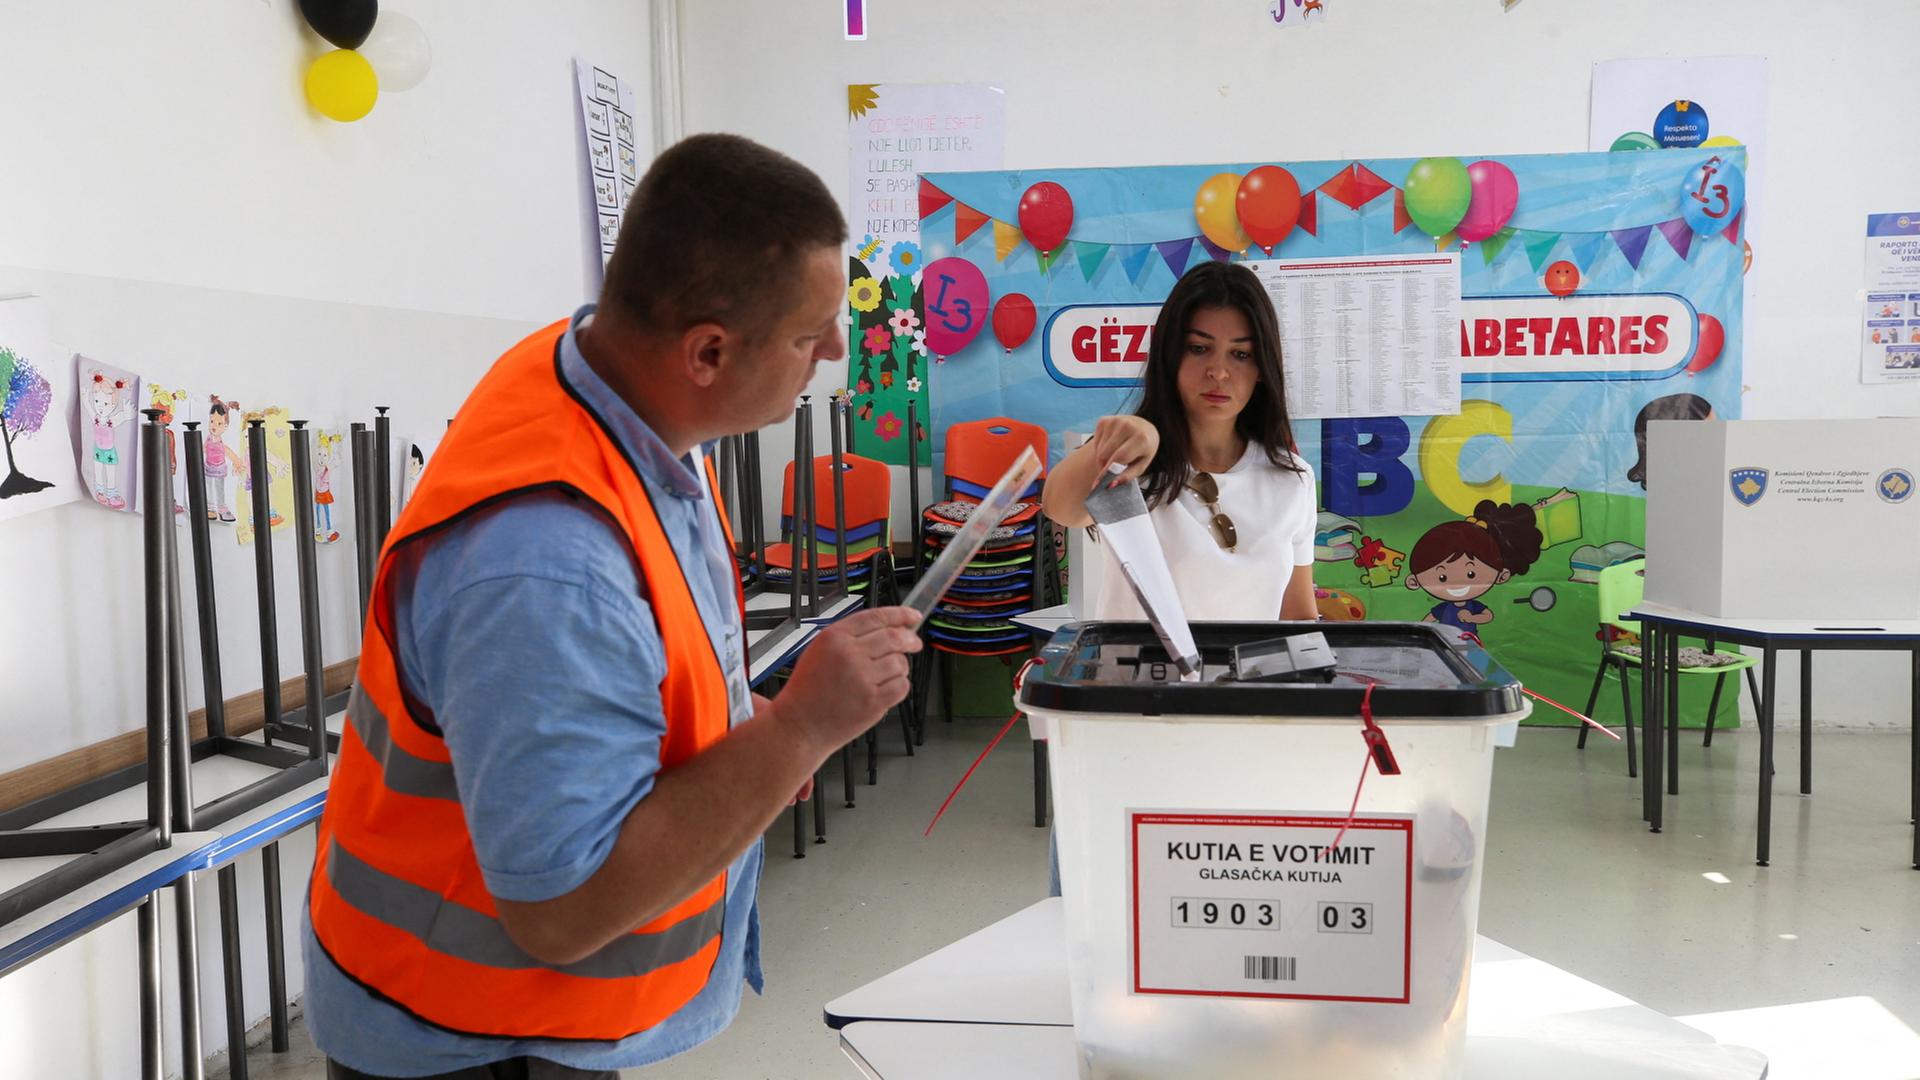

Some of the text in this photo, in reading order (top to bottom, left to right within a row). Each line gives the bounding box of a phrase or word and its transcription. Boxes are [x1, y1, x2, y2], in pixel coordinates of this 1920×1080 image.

[1664, 125, 1698, 134] Respekto
[1071, 317, 1155, 363] GËZ
[1167, 842, 1375, 865] KUTIA E VOTIMIT
[1199, 866, 1342, 883] GLASAČKA KUTIJA
[1176, 901, 1367, 929] 1903 03
